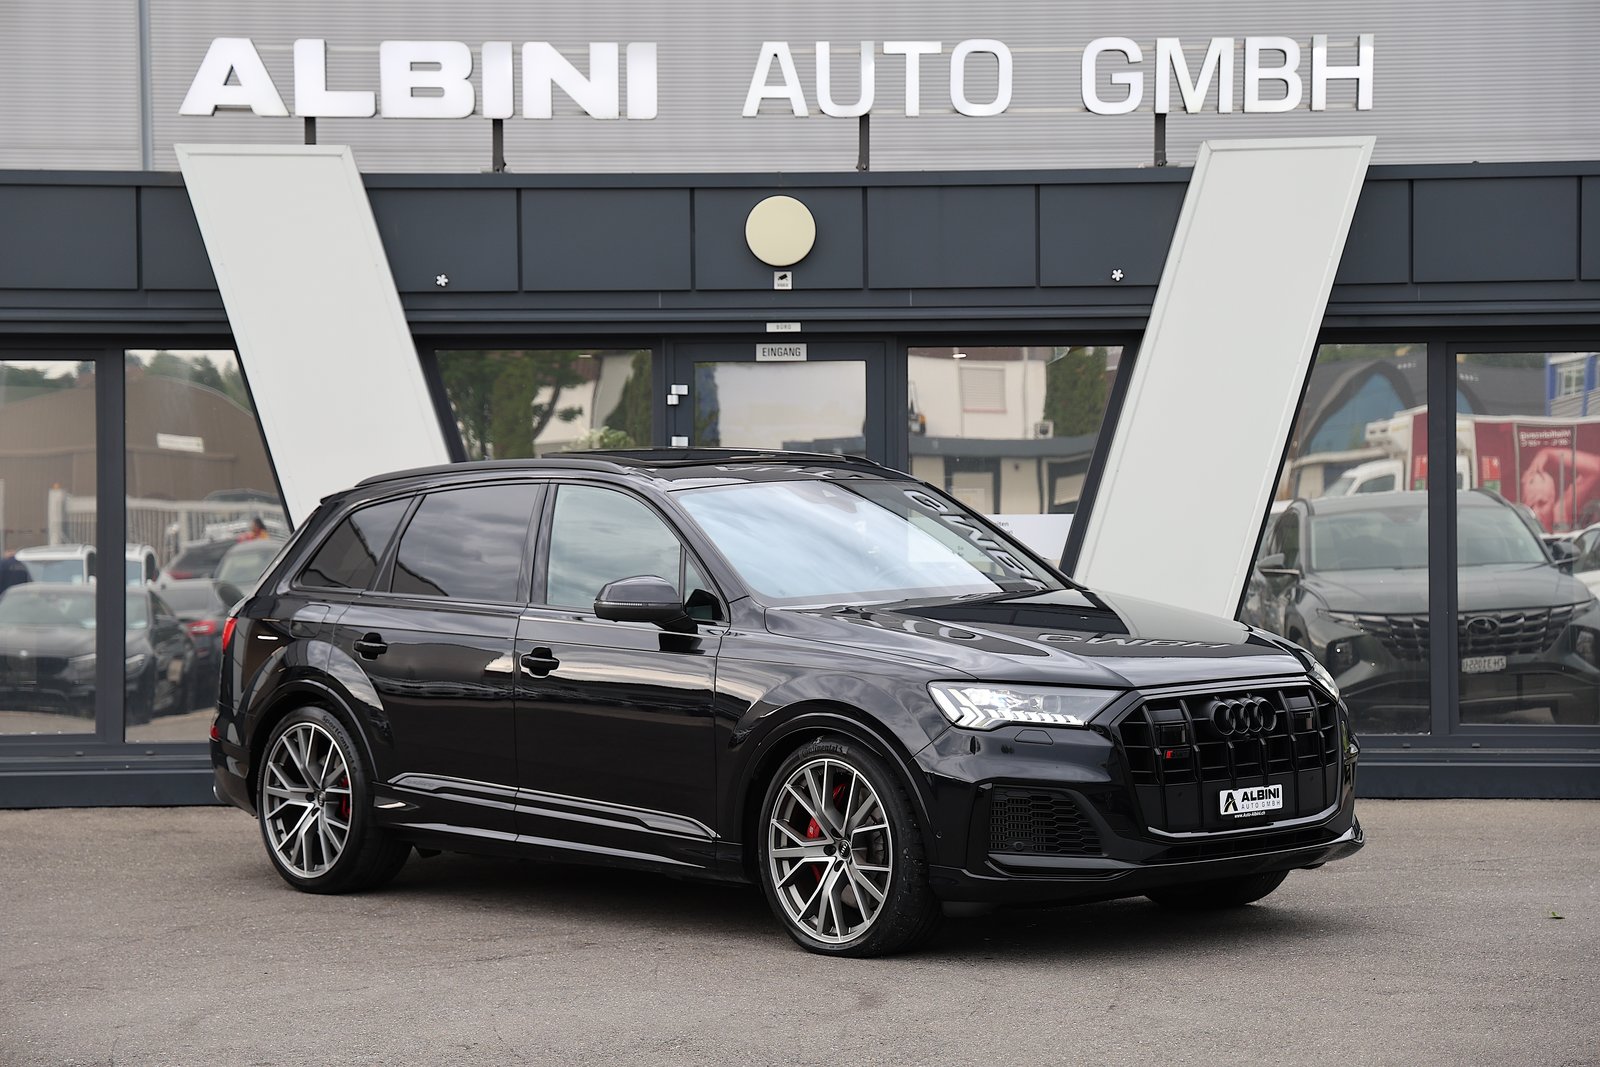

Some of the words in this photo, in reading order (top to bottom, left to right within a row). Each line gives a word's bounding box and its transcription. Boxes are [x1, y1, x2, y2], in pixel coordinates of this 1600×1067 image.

[178, 36, 658, 120] ALBINI
[742, 38, 1013, 117] AUTO
[1080, 34, 1374, 115] GMBH
[762, 347, 801, 357] EINGANG
[1241, 787, 1280, 802] ALBINI
[1261, 800, 1280, 808] GMBH
